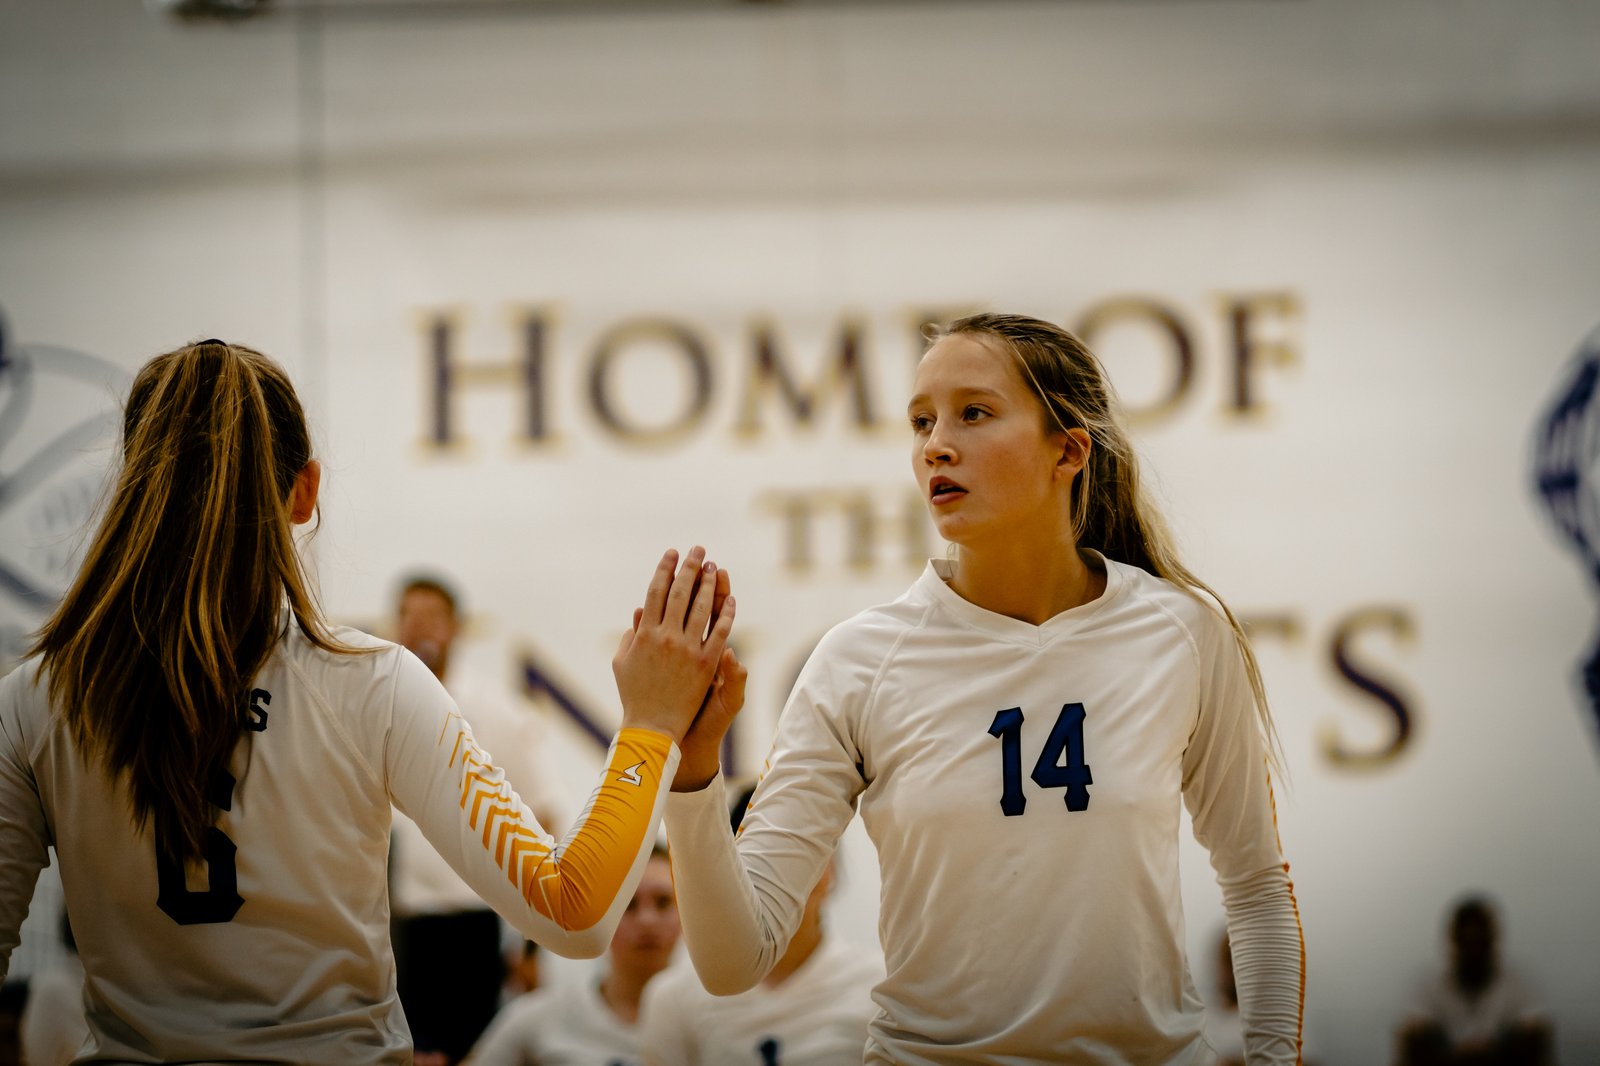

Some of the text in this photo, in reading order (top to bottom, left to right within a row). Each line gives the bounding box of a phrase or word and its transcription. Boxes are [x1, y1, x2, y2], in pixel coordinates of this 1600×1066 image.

[413, 289, 1304, 456] HOM OF
[757, 486, 934, 576] TH
[988, 702, 1093, 817] 14
